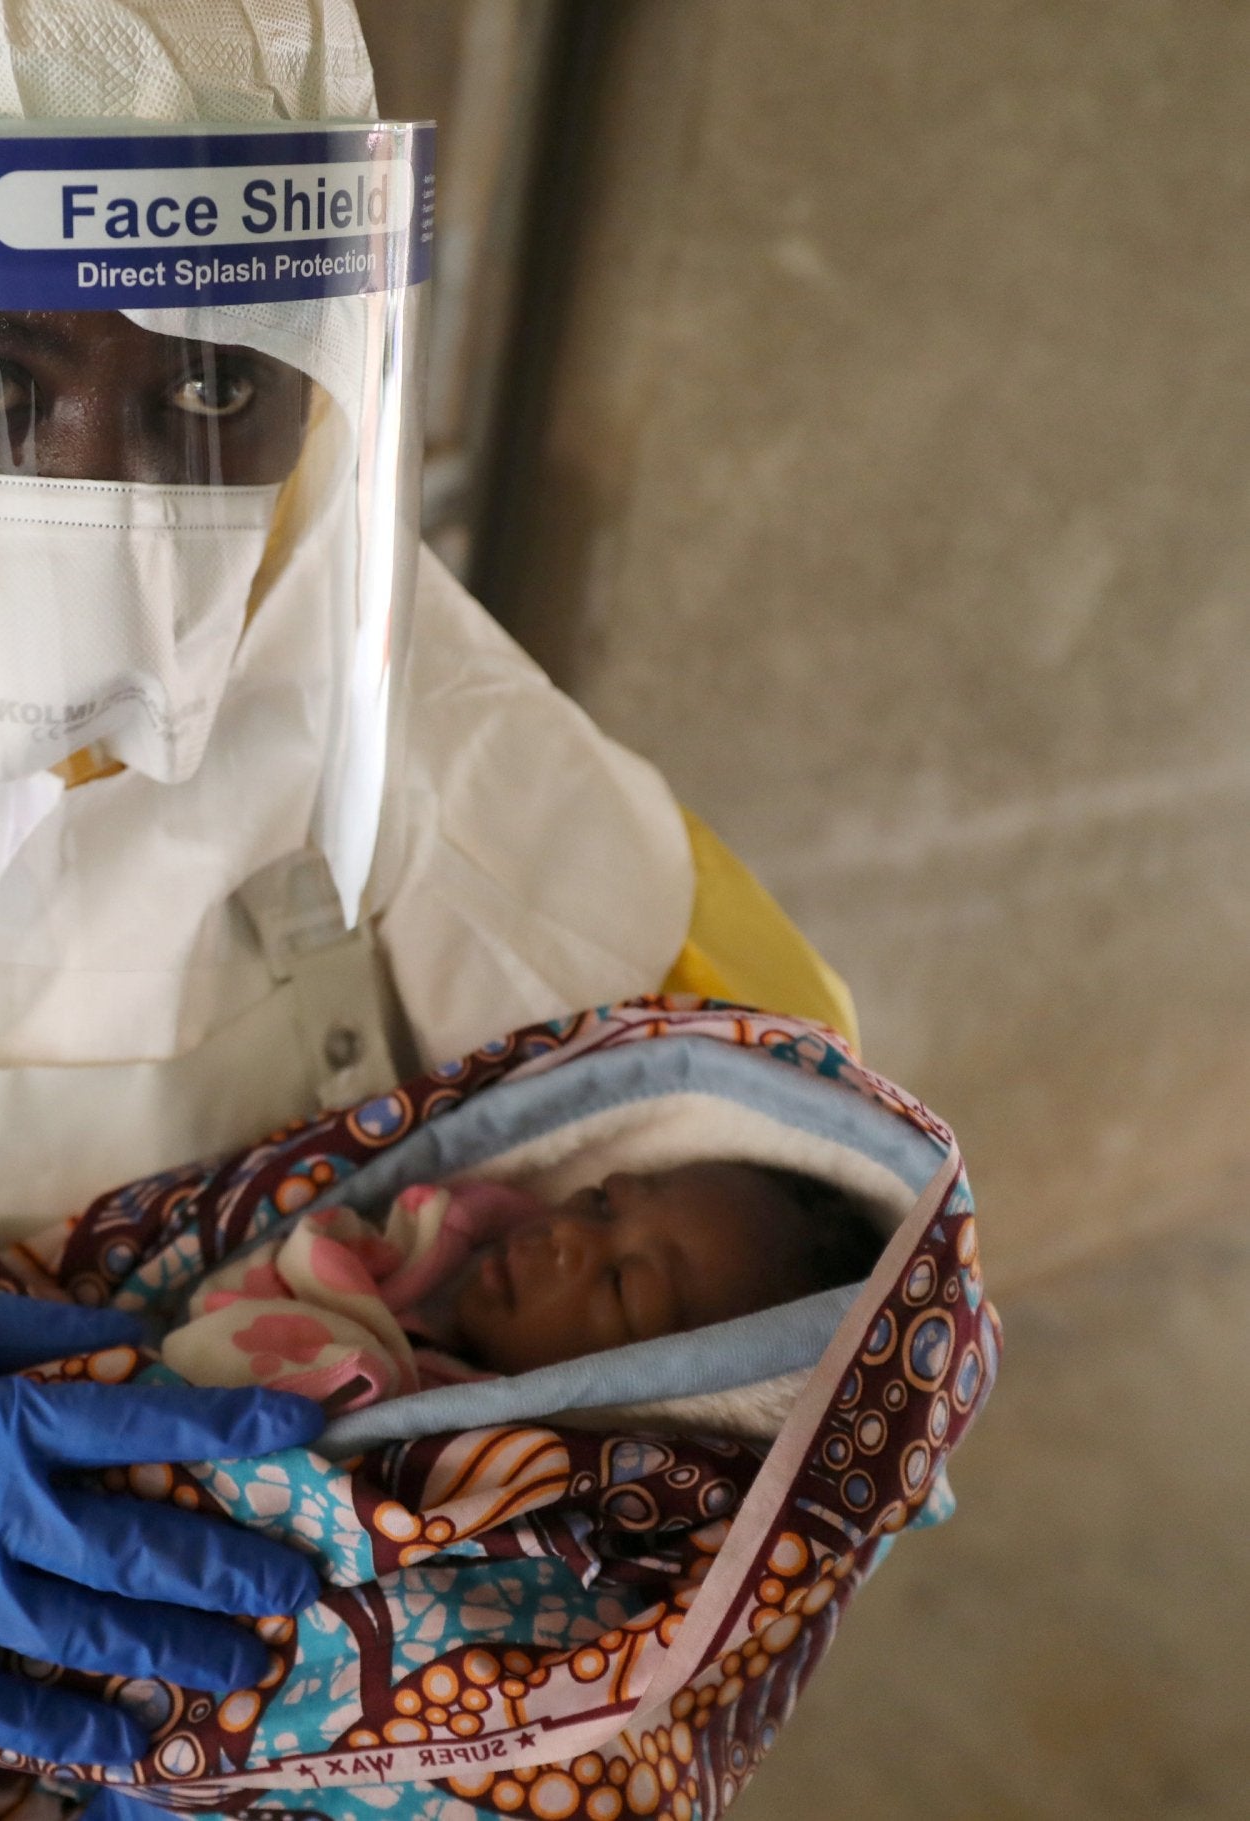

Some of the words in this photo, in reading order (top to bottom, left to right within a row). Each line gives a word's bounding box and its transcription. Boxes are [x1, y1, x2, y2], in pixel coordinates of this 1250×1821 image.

[61, 184, 218, 239] Face
[241, 173, 389, 236] Shield
[77, 261, 165, 289] Direct
[174, 256, 267, 291] Splash
[274, 250, 378, 281] Protection
